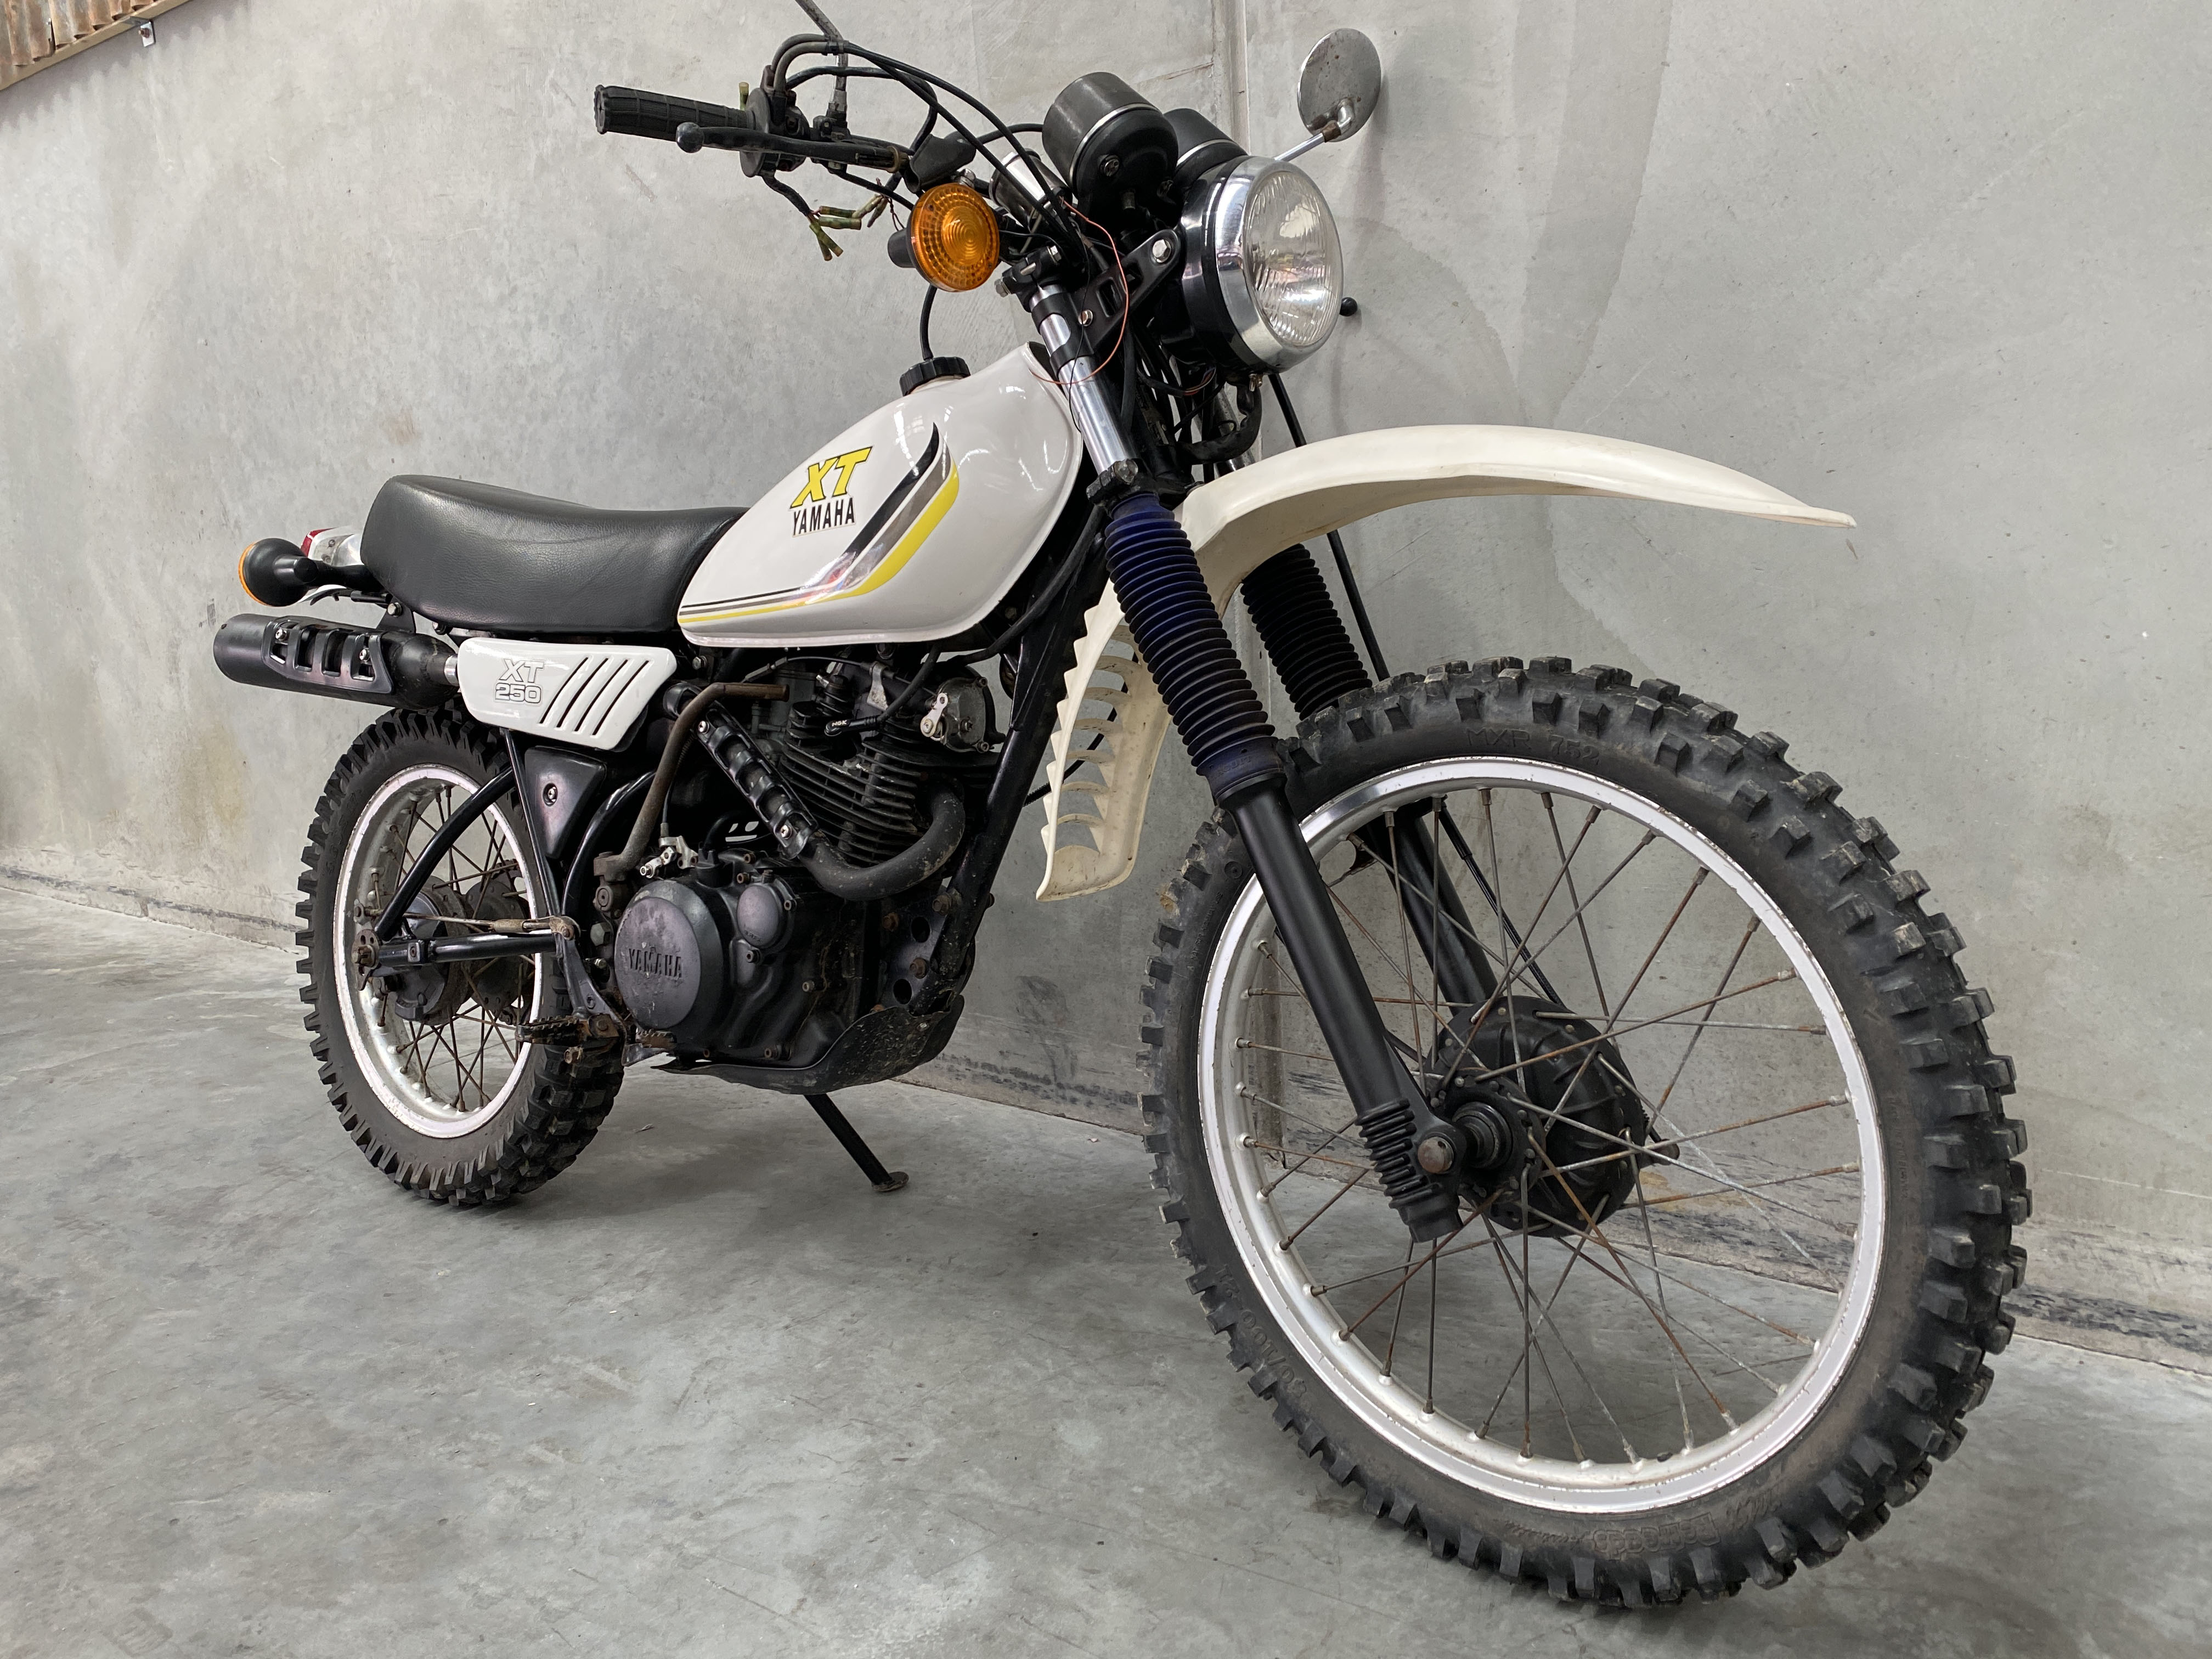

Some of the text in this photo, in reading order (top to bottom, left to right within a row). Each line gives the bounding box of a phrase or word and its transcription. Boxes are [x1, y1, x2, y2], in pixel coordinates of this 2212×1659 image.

[790, 446, 873, 509] XT
[792, 497, 855, 536] YAMAHA
[499, 658, 545, 684] XT
[495, 682, 542, 704] 250
[1466, 727, 1532, 751] MXR
[628, 948, 682, 978] YAMAHA
